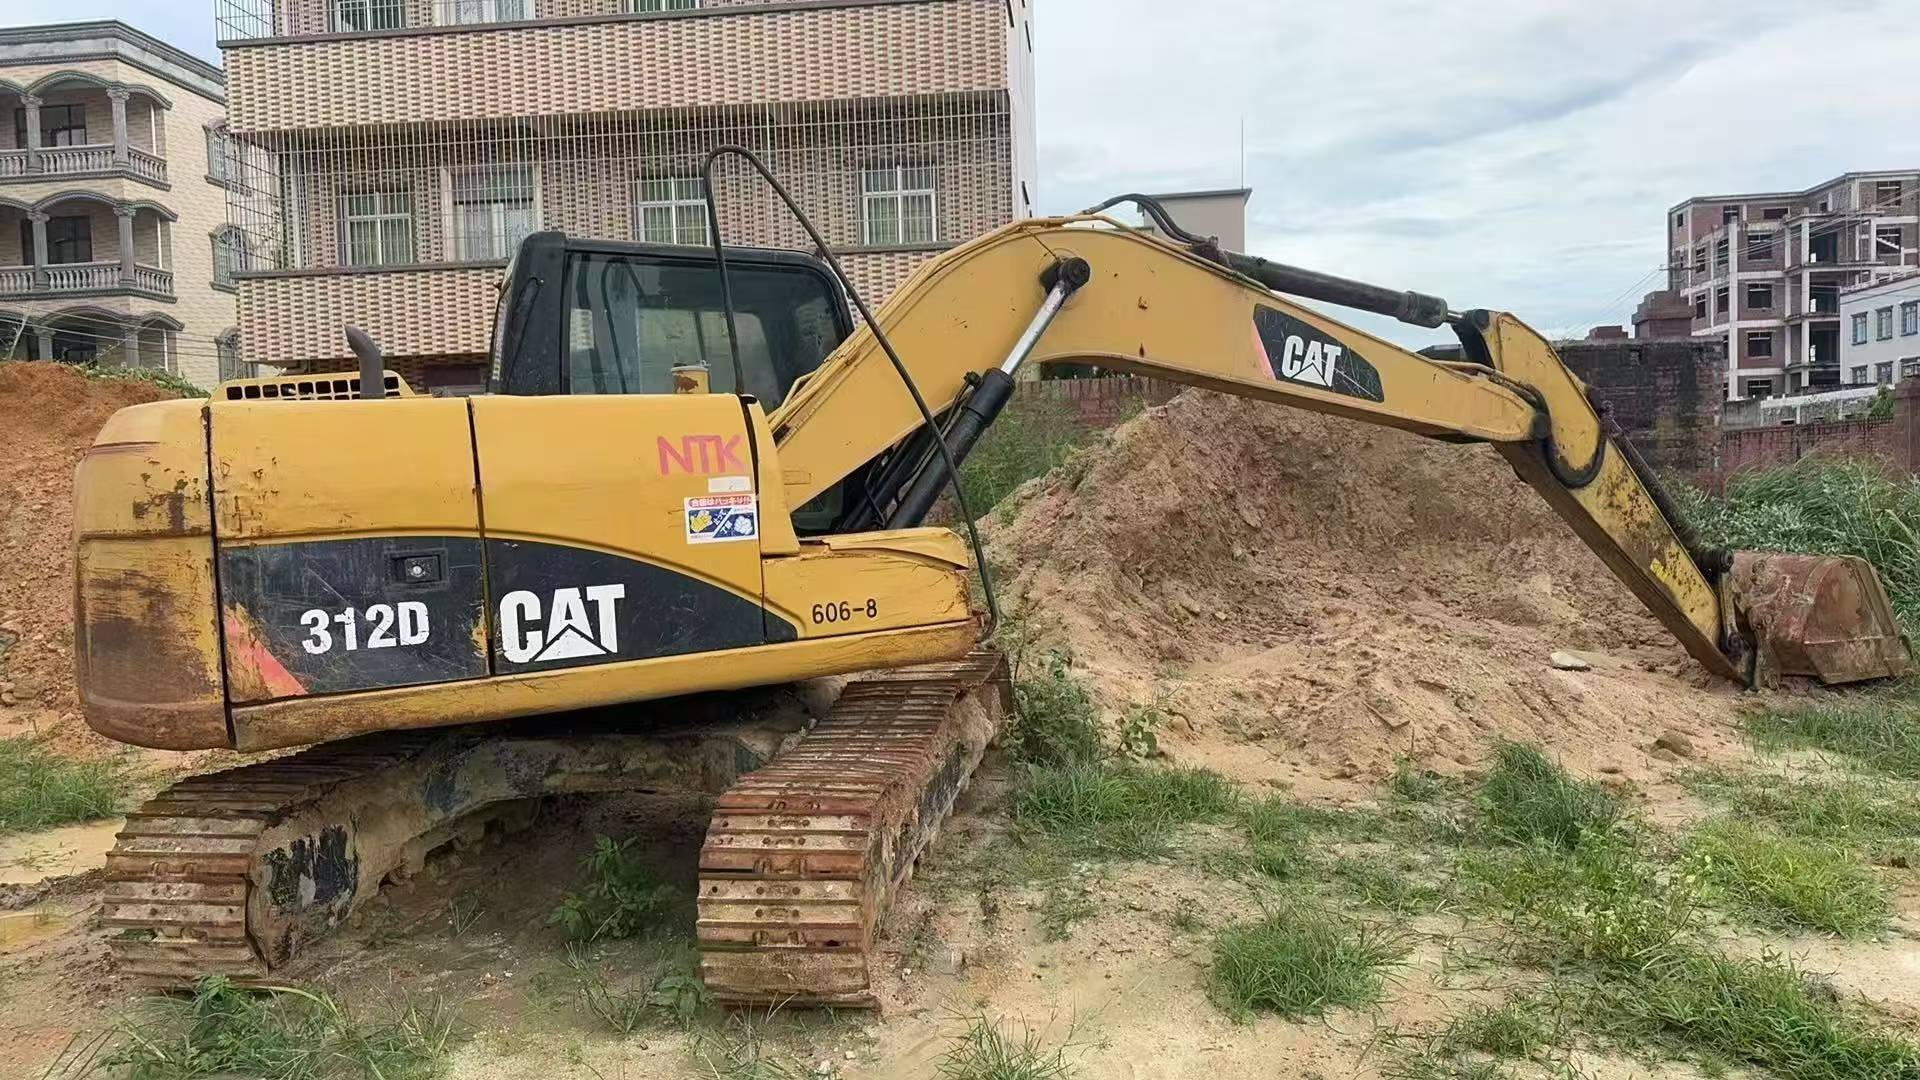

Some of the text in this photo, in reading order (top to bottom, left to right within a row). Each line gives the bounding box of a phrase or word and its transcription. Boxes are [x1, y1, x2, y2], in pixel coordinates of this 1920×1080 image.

[1281, 335, 1342, 387] CAT
[657, 435, 745, 476] NTK
[300, 601, 430, 655] 312D
[500, 583, 625, 664] CAT
[812, 598, 878, 624] 606-8
